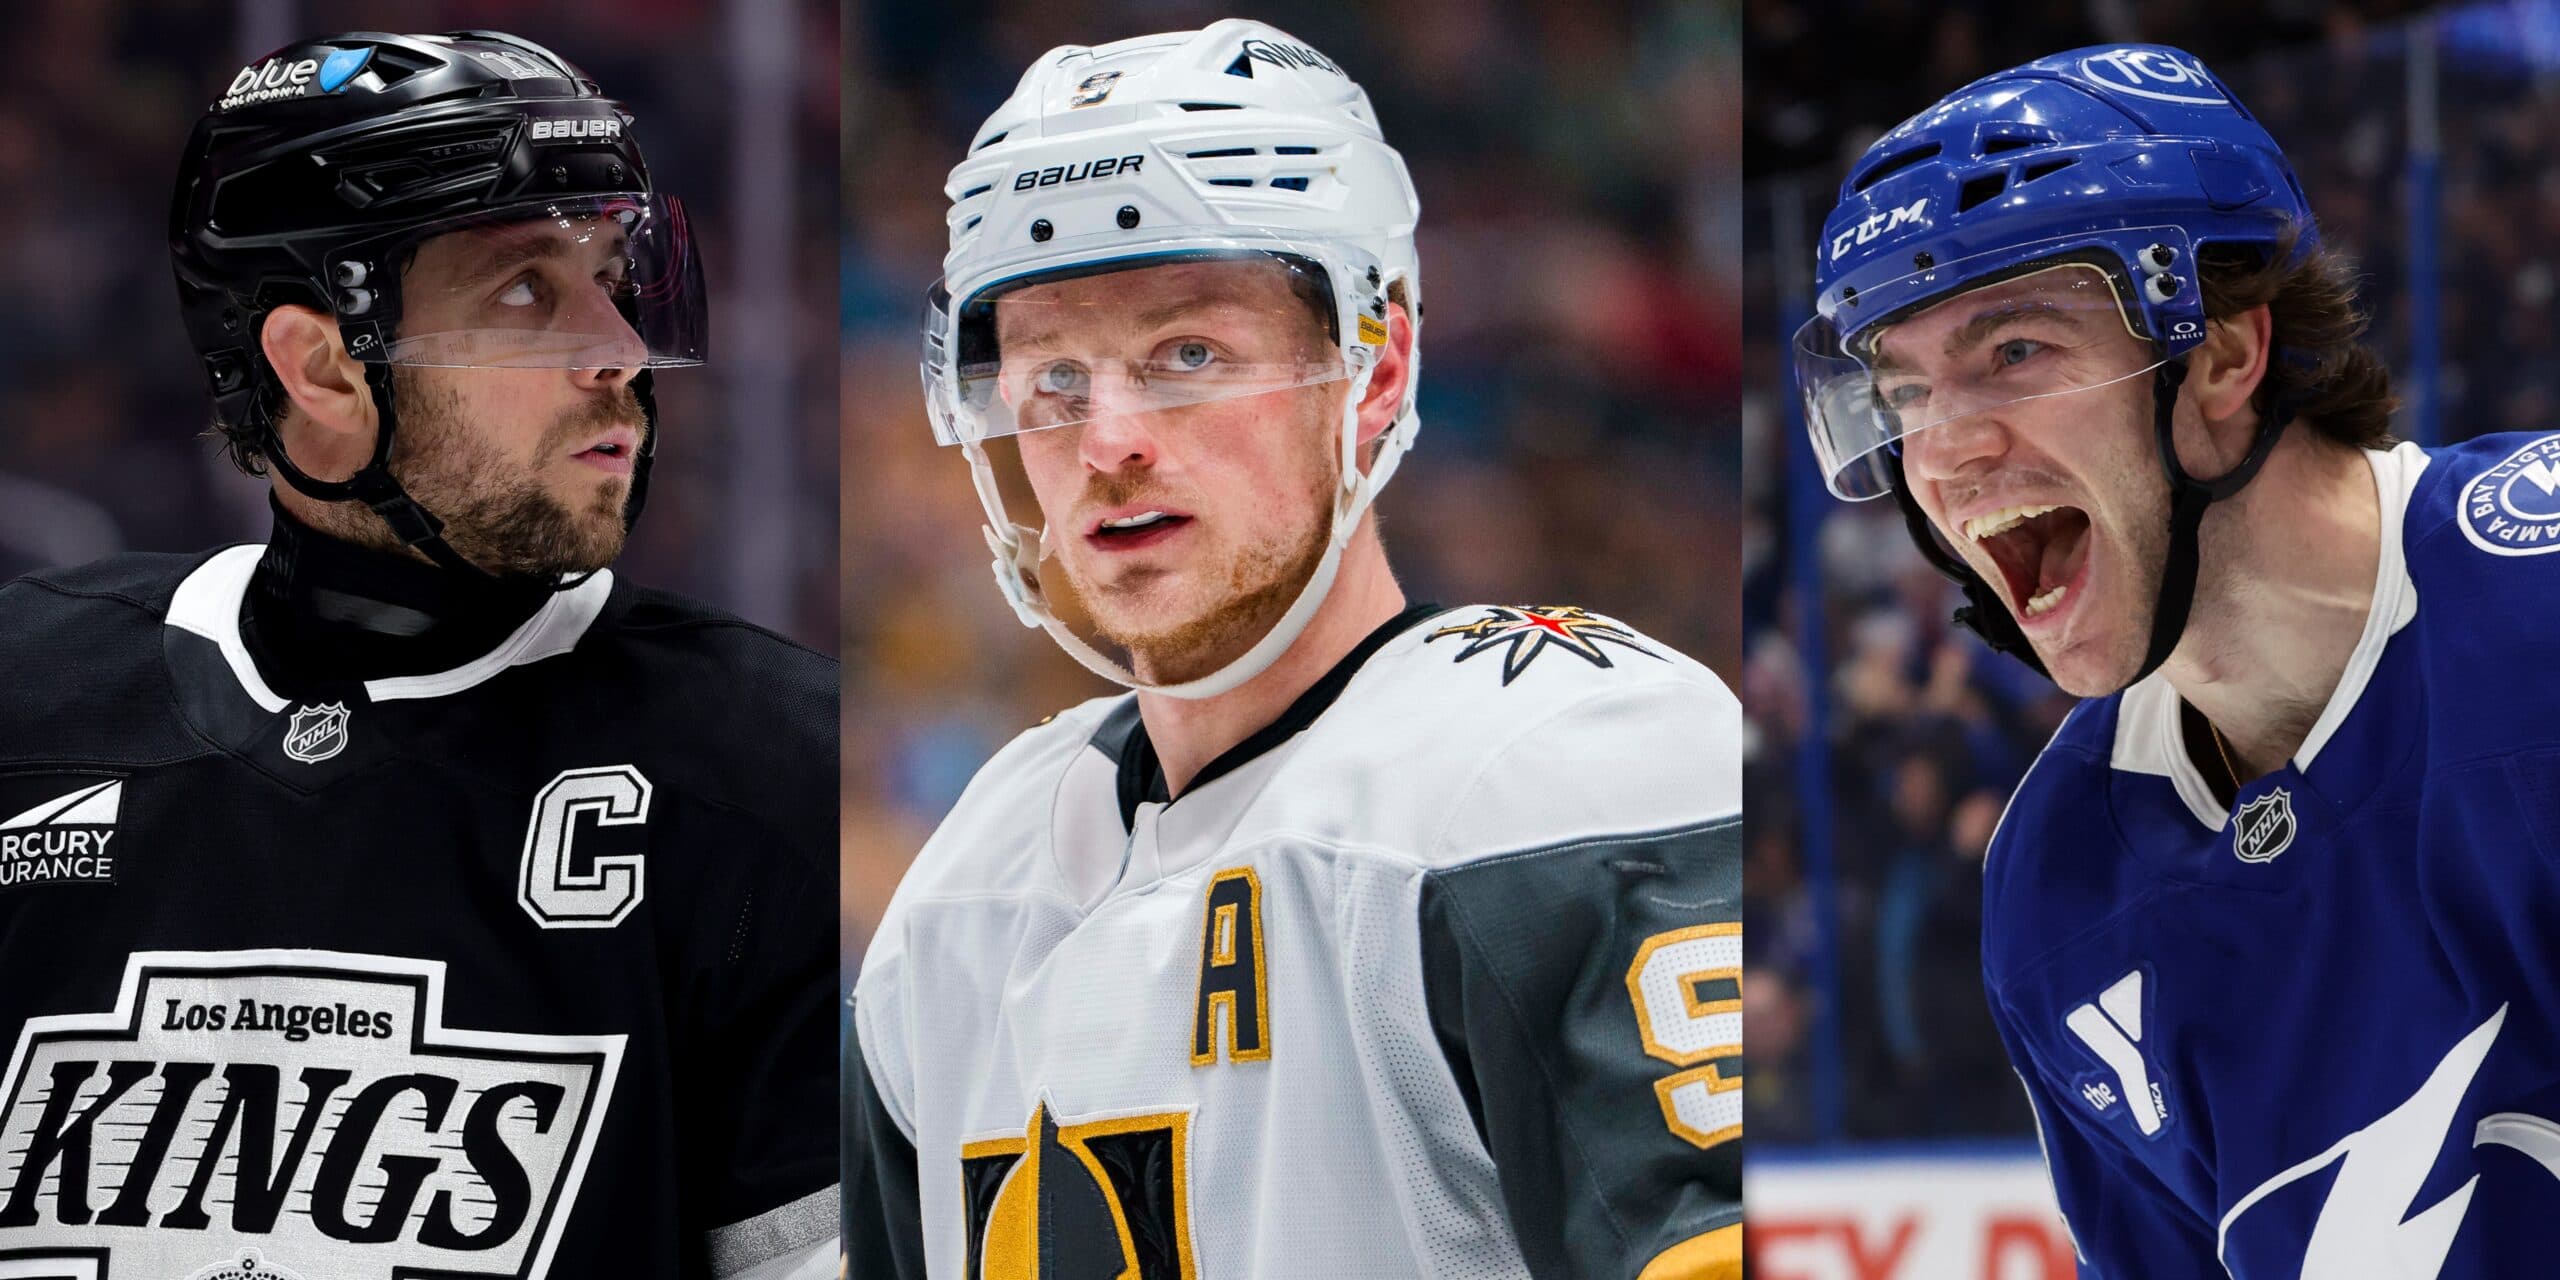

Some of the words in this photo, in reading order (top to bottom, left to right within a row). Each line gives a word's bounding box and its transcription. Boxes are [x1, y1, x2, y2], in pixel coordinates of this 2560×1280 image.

[226, 58, 318, 98] blue
[480, 52, 562, 79] 11
[219, 84, 306, 110] CALIFORNIA
[1830, 198, 1929, 261] CCM
[2471, 484, 2497, 520] BAY
[297, 719, 338, 752] NHL
[517, 763, 653, 930] C
[2248, 807, 2282, 853] NHL
[1189, 865, 1272, 1068] A
[161, 999, 225, 1033] Los
[230, 999, 394, 1042] Angeles
[2081, 1081, 2117, 1112] the
[2148, 1081, 2169, 1120] YMCA
[0, 1059, 567, 1251] KINGS
